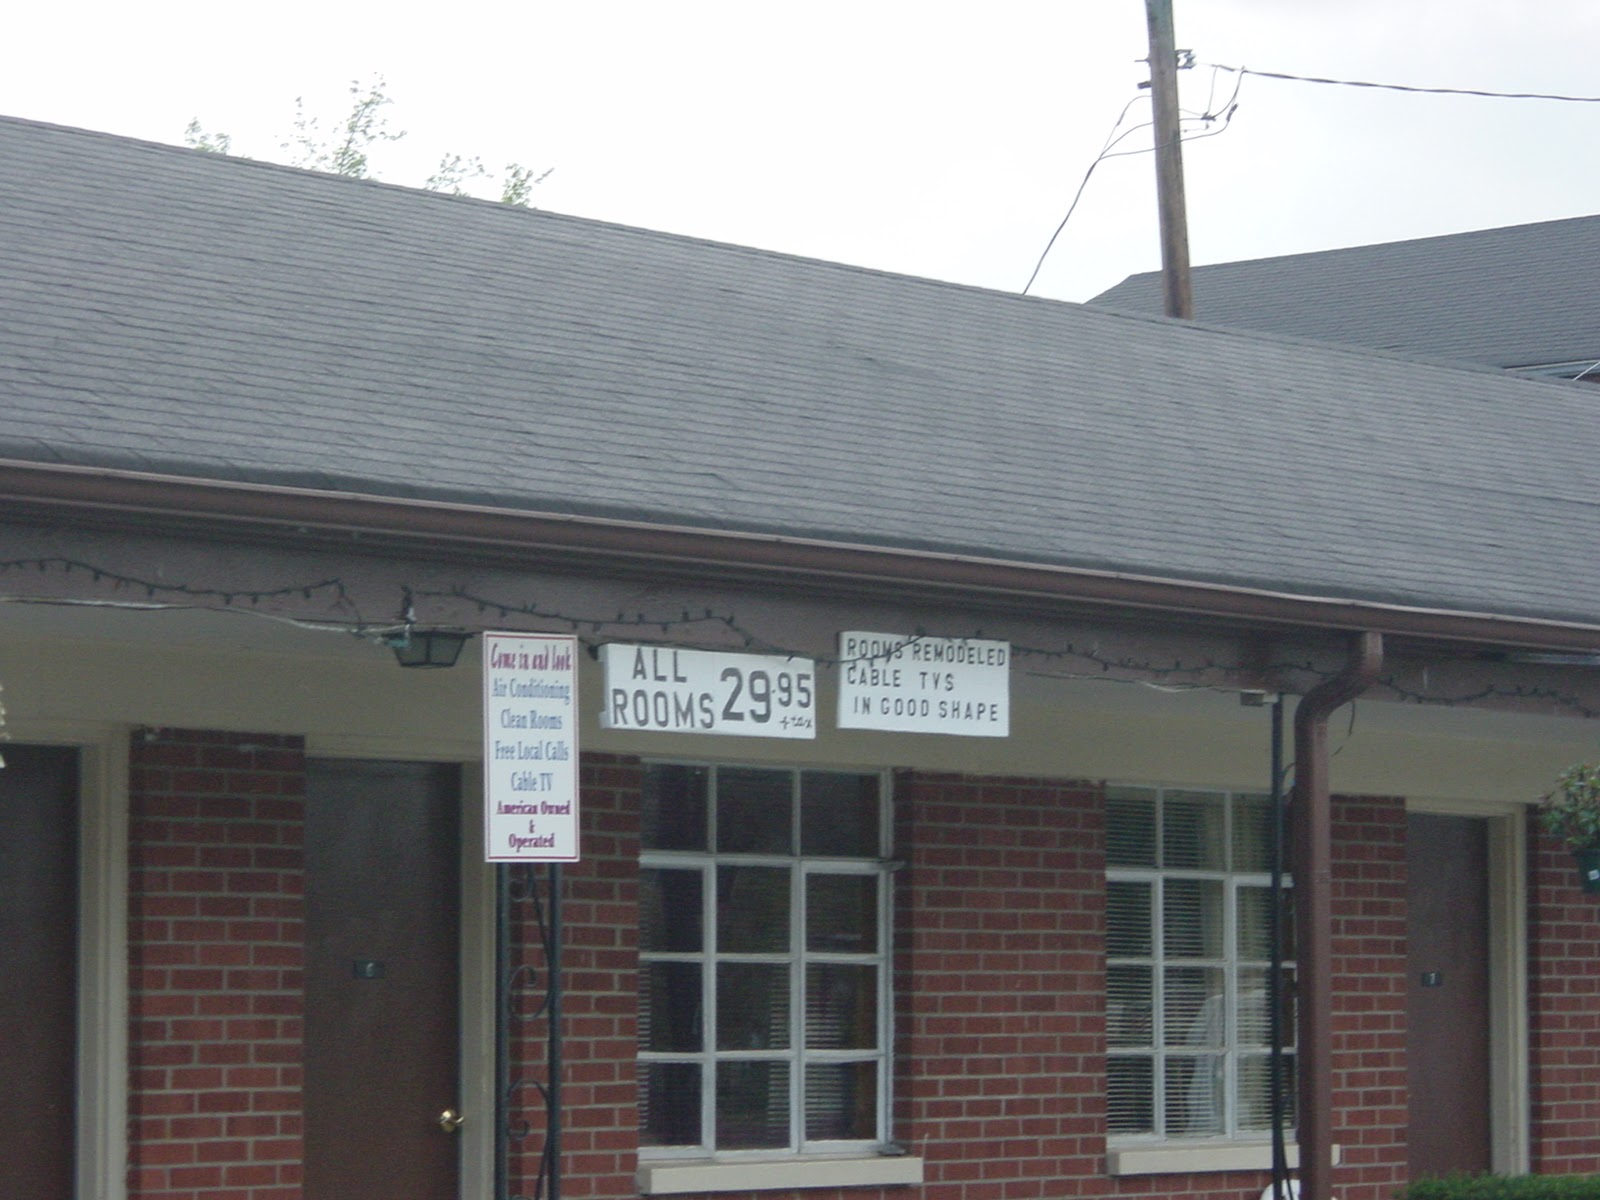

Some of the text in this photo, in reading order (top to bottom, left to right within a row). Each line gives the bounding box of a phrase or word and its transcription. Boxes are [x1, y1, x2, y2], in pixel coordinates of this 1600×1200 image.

[491, 643, 571, 670] Come in and look
[847, 638, 1006, 667] ROOMS REMODELED
[632, 648, 687, 682] ALL
[847, 667, 955, 691] CABLE TVS
[491, 678, 570, 705] Air Conditioning
[501, 708, 562, 730] Clean Rooms
[612, 688, 715, 729] ROOMS
[854, 696, 998, 721] IN GOOD SHAPE
[495, 740, 569, 760] Free Local Calls
[511, 771, 553, 791] Cable TV
[496, 800, 571, 815] American Owned
[508, 833, 555, 853] Operated
